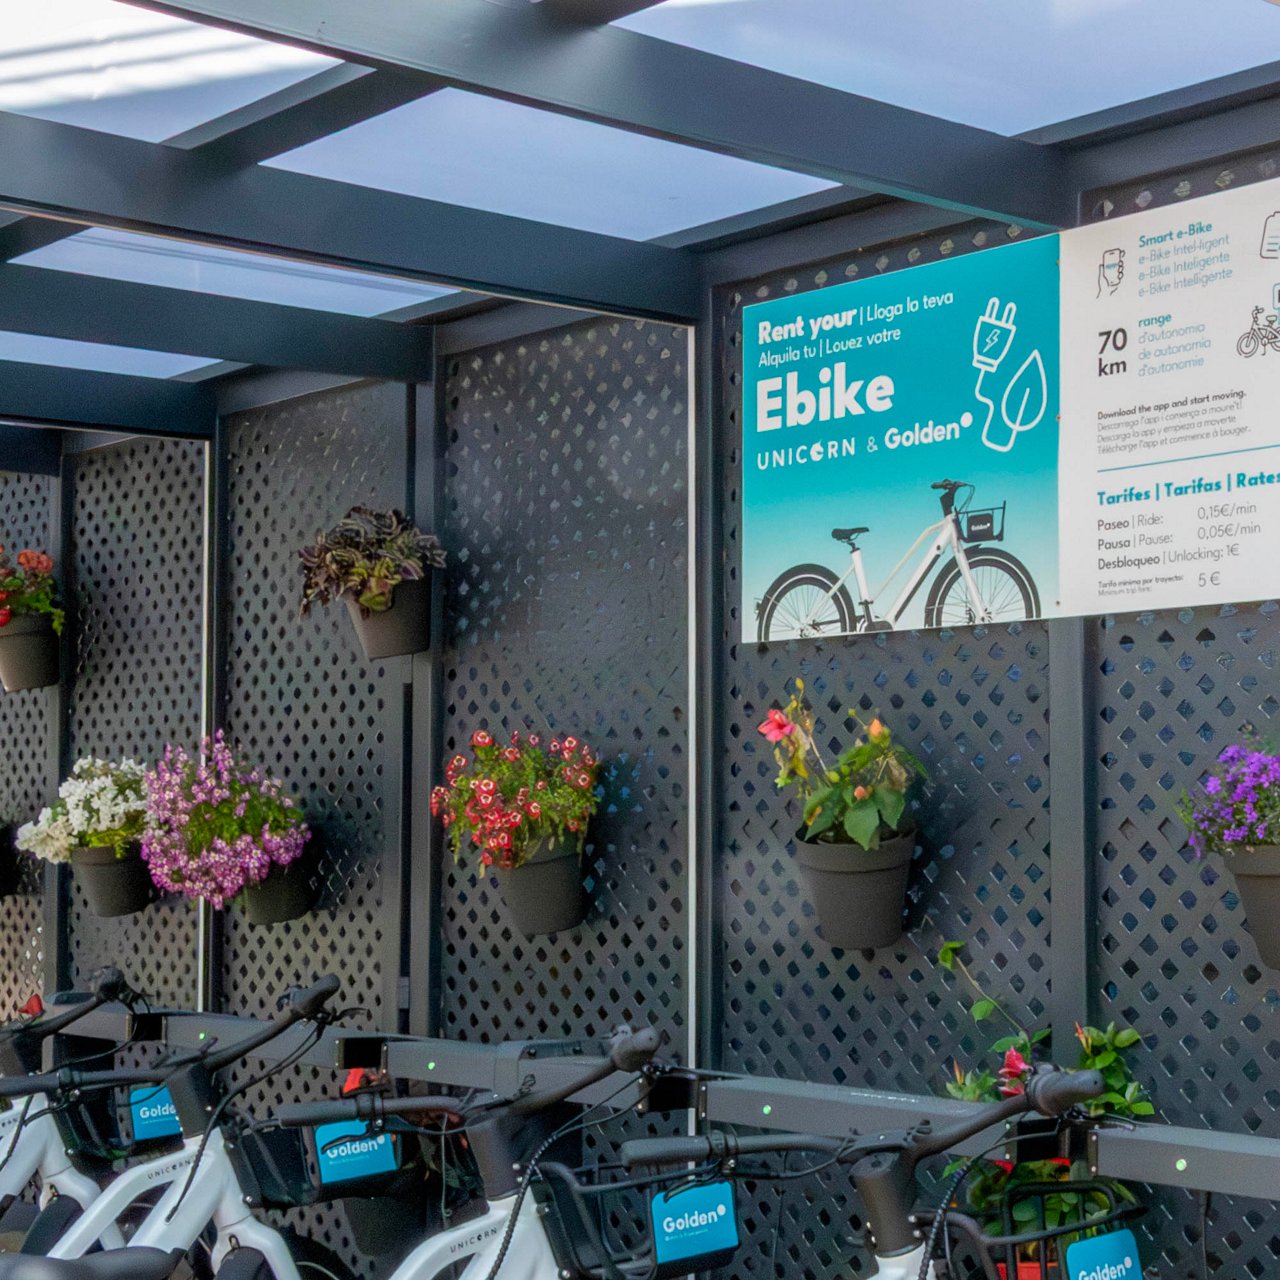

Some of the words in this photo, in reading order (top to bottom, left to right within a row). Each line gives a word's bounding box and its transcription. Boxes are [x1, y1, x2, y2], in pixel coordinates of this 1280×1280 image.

[1139, 231, 1173, 248] Smart
[1177, 222, 1213, 239] e-Bike
[1138, 248, 1171, 264] e-Bike
[1138, 264, 1171, 281] e-Bike
[1138, 280, 1171, 297] e-Bike
[758, 315, 804, 344] Rent
[809, 309, 857, 339] your
[867, 303, 903, 322] Lloga
[906, 297, 919, 313] la
[922, 292, 954, 309] teva
[1138, 313, 1172, 327] range
[758, 345, 800, 368] Alquila
[803, 344, 816, 358] tu
[825, 336, 863, 354] Louez
[866, 328, 901, 345] votre
[1098, 327, 1128, 355] 70
[1098, 357, 1127, 377] km
[756, 361, 895, 433] Ebike
[1098, 405, 1136, 420] Download
[1138, 404, 1151, 413] the
[1153, 403, 1170, 413] app
[1172, 396, 1188, 407] and
[1190, 394, 1210, 405] start
[1212, 389, 1247, 401] moving.
[757, 437, 856, 470] UNICORN
[866, 436, 879, 453] &
[884, 420, 960, 449] Golden
[1097, 487, 1151, 506] Tarifes
[1164, 477, 1221, 498] Tarifas
[1197, 501, 1257, 520] 0,15€/min
[1097, 519, 1130, 531] Paseo
[1137, 513, 1164, 527] Ride:
[1197, 521, 1261, 540] 0,05€/min
[1097, 538, 1131, 551] Pausa
[1138, 533, 1173, 547] Pause:
[1097, 555, 1161, 570] Desbloqueo
[1168, 547, 1224, 563] Unlocking:
[1226, 543, 1240, 557] 1€
[1198, 572, 1207, 588] 5
[1210, 571, 1221, 586] €
[140, 1103, 176, 1118] Golde
[663, 1210, 718, 1233] Golden
[449, 1227, 497, 1253] UNICORN
